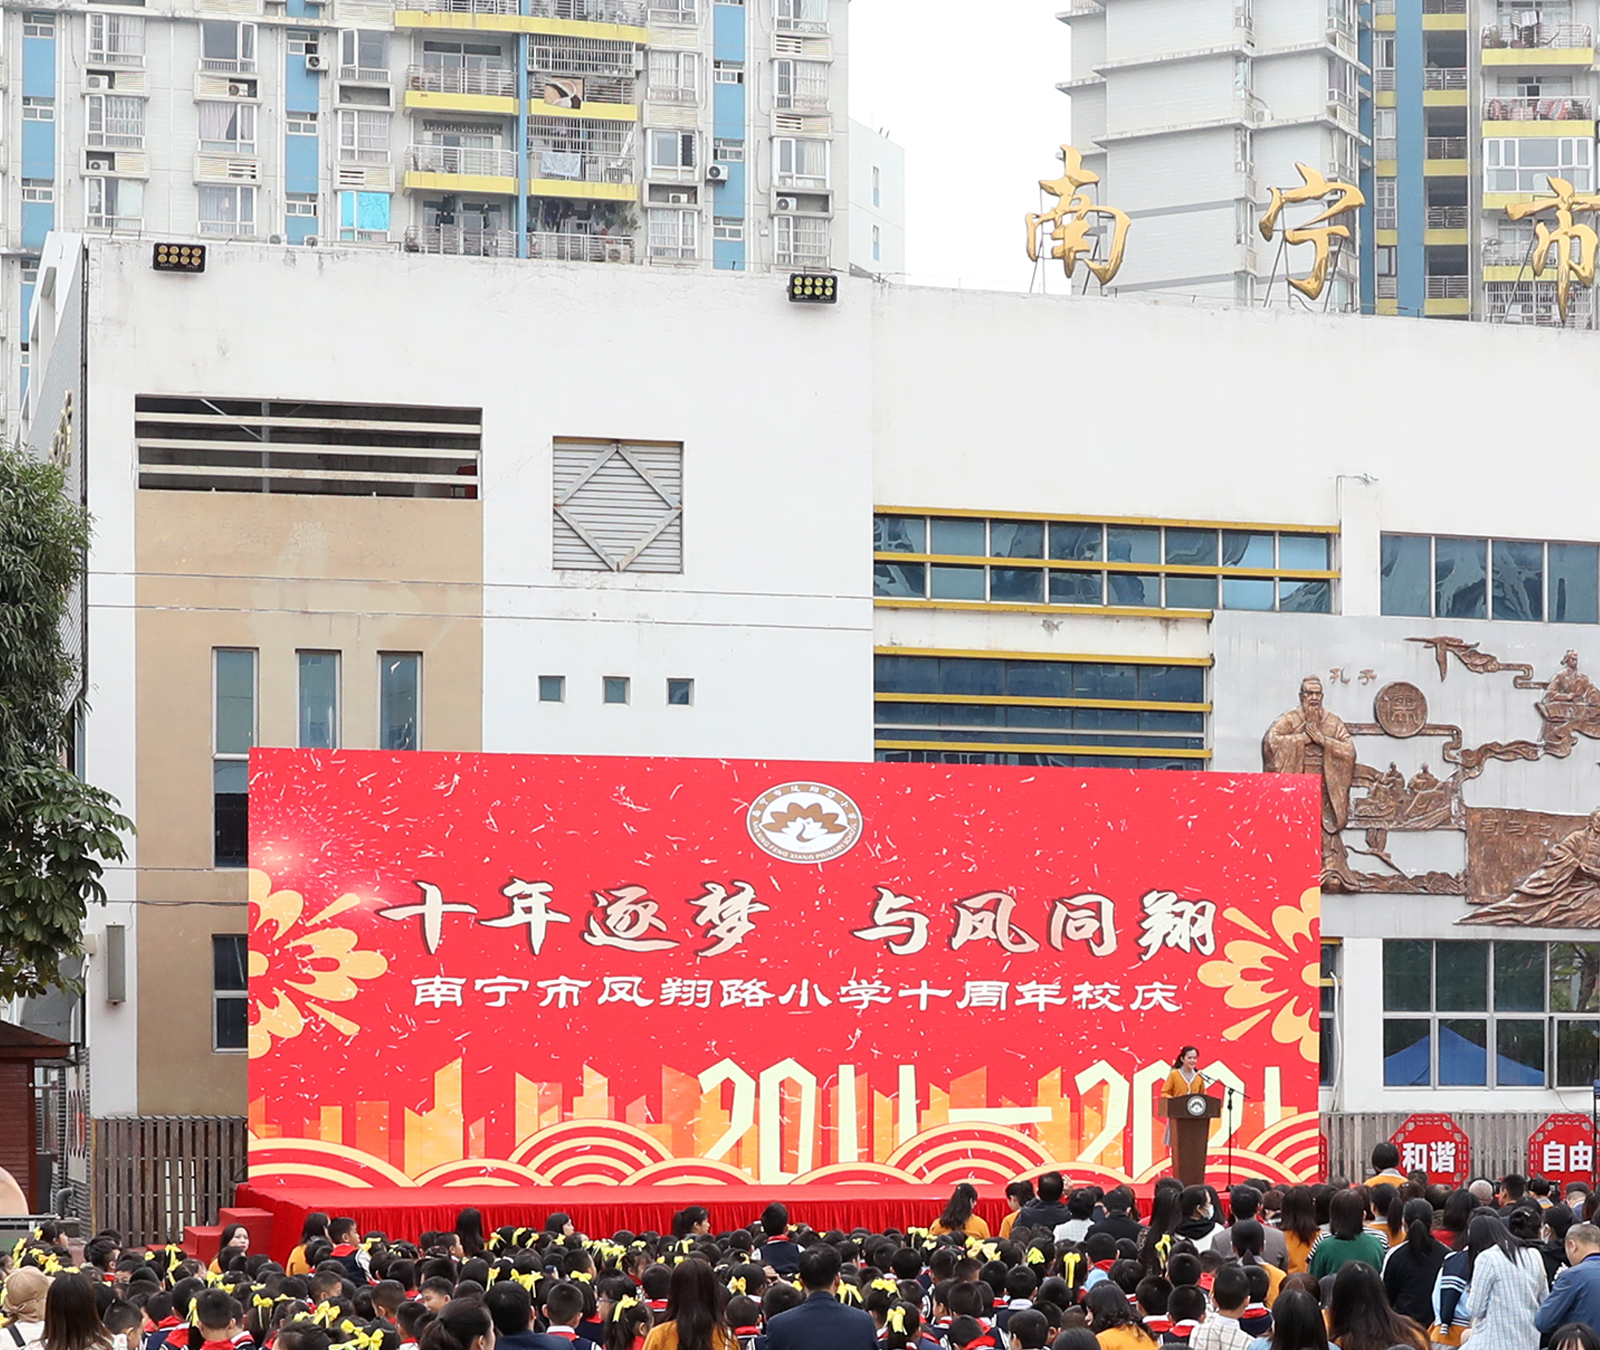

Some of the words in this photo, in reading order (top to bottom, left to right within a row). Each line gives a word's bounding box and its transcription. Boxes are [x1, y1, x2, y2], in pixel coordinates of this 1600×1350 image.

[1328, 667, 1378, 685] 孔子
[383, 878, 770, 957] 十年逐梦
[853, 886, 1218, 962] 与凤同翔
[411, 973, 1184, 1015] 南宁市凤翔路小学十周年校庆
[1402, 1141, 1456, 1173] 和谐
[1542, 1141, 1594, 1172] 自由
